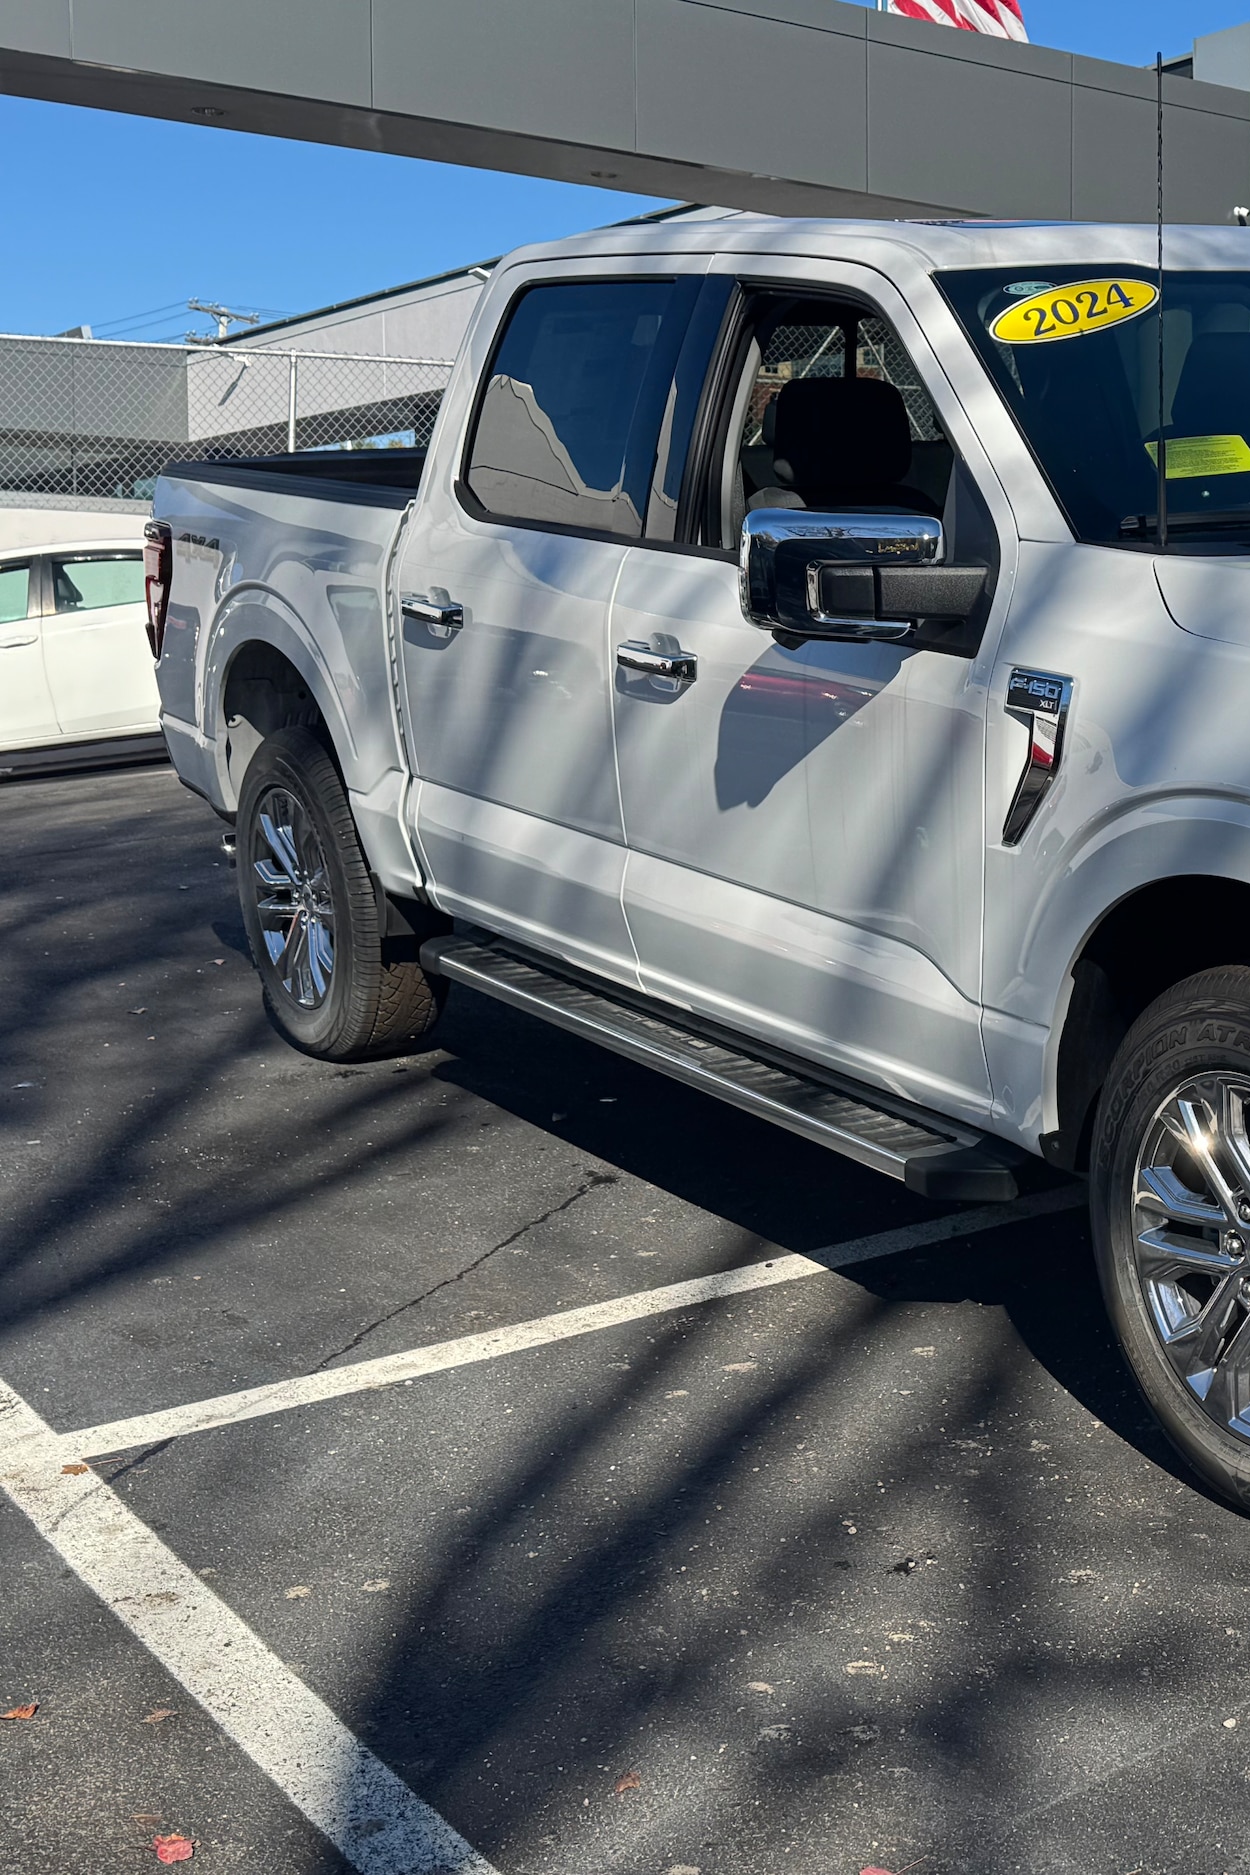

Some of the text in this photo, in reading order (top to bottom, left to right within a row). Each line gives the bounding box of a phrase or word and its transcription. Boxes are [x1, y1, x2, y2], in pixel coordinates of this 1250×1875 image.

[1023, 283, 1135, 337] 2024
[1010, 677, 1060, 699] F-150
[1039, 699, 1055, 709] XLT
